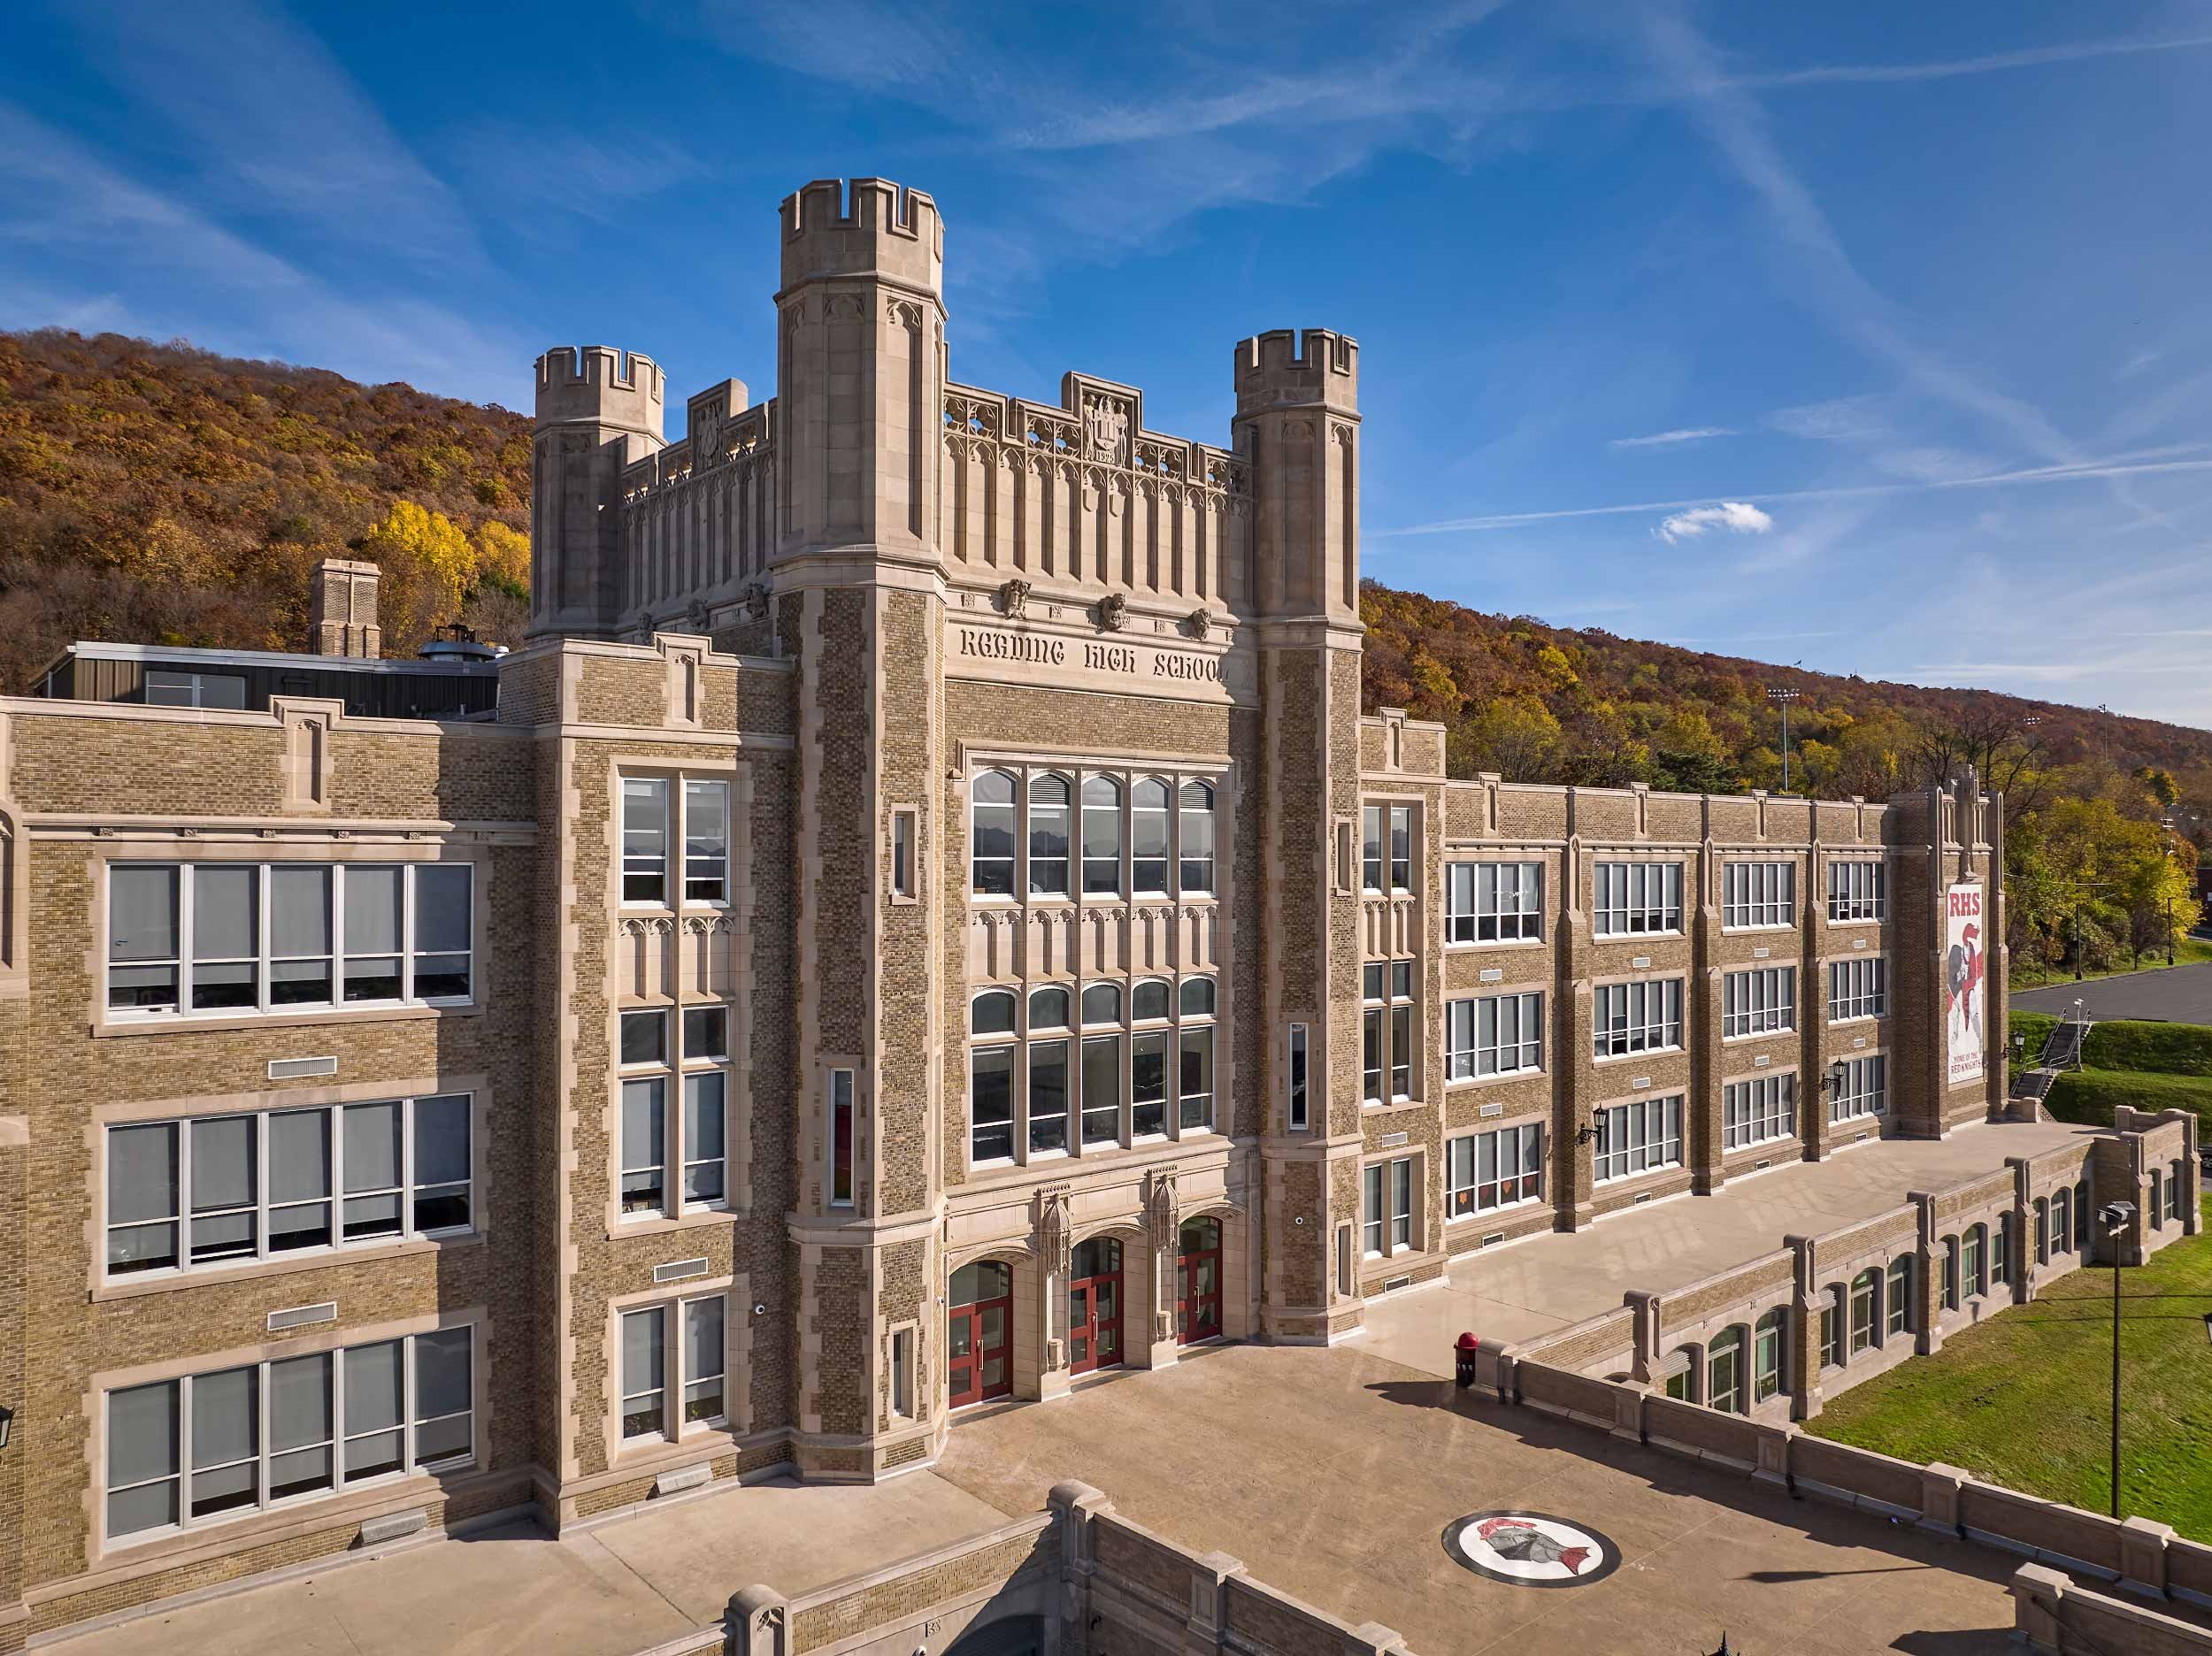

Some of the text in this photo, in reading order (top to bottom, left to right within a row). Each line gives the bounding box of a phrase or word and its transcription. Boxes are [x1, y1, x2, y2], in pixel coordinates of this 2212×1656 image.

[960, 629, 1064, 665] READING
[1084, 643, 1135, 673] HIGH
[1949, 893, 1980, 917] RHS
